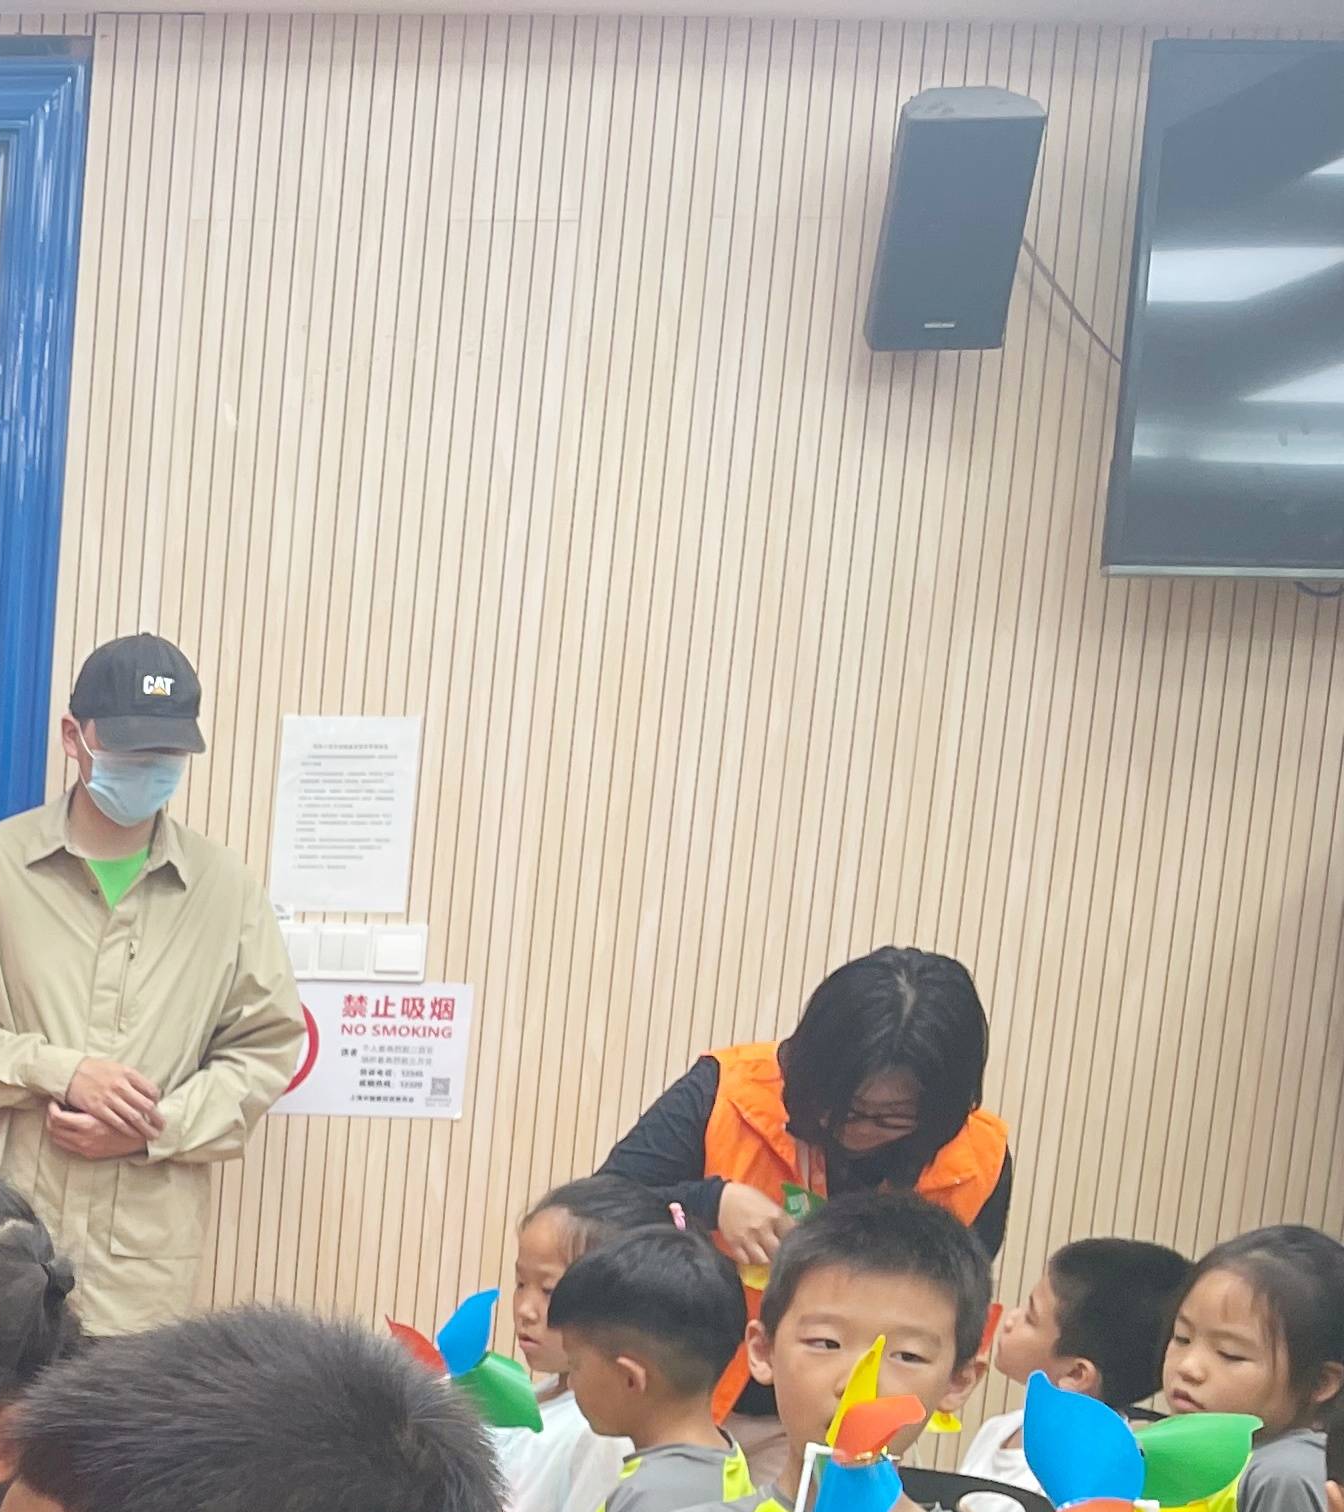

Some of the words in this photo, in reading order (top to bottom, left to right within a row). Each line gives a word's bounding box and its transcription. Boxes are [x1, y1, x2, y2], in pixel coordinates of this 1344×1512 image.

[143, 675, 175, 696] CAT
[342, 994, 455, 1021] 禁止吸烟
[341, 1024, 366, 1035] NO
[372, 1025, 453, 1038] SMOKING
